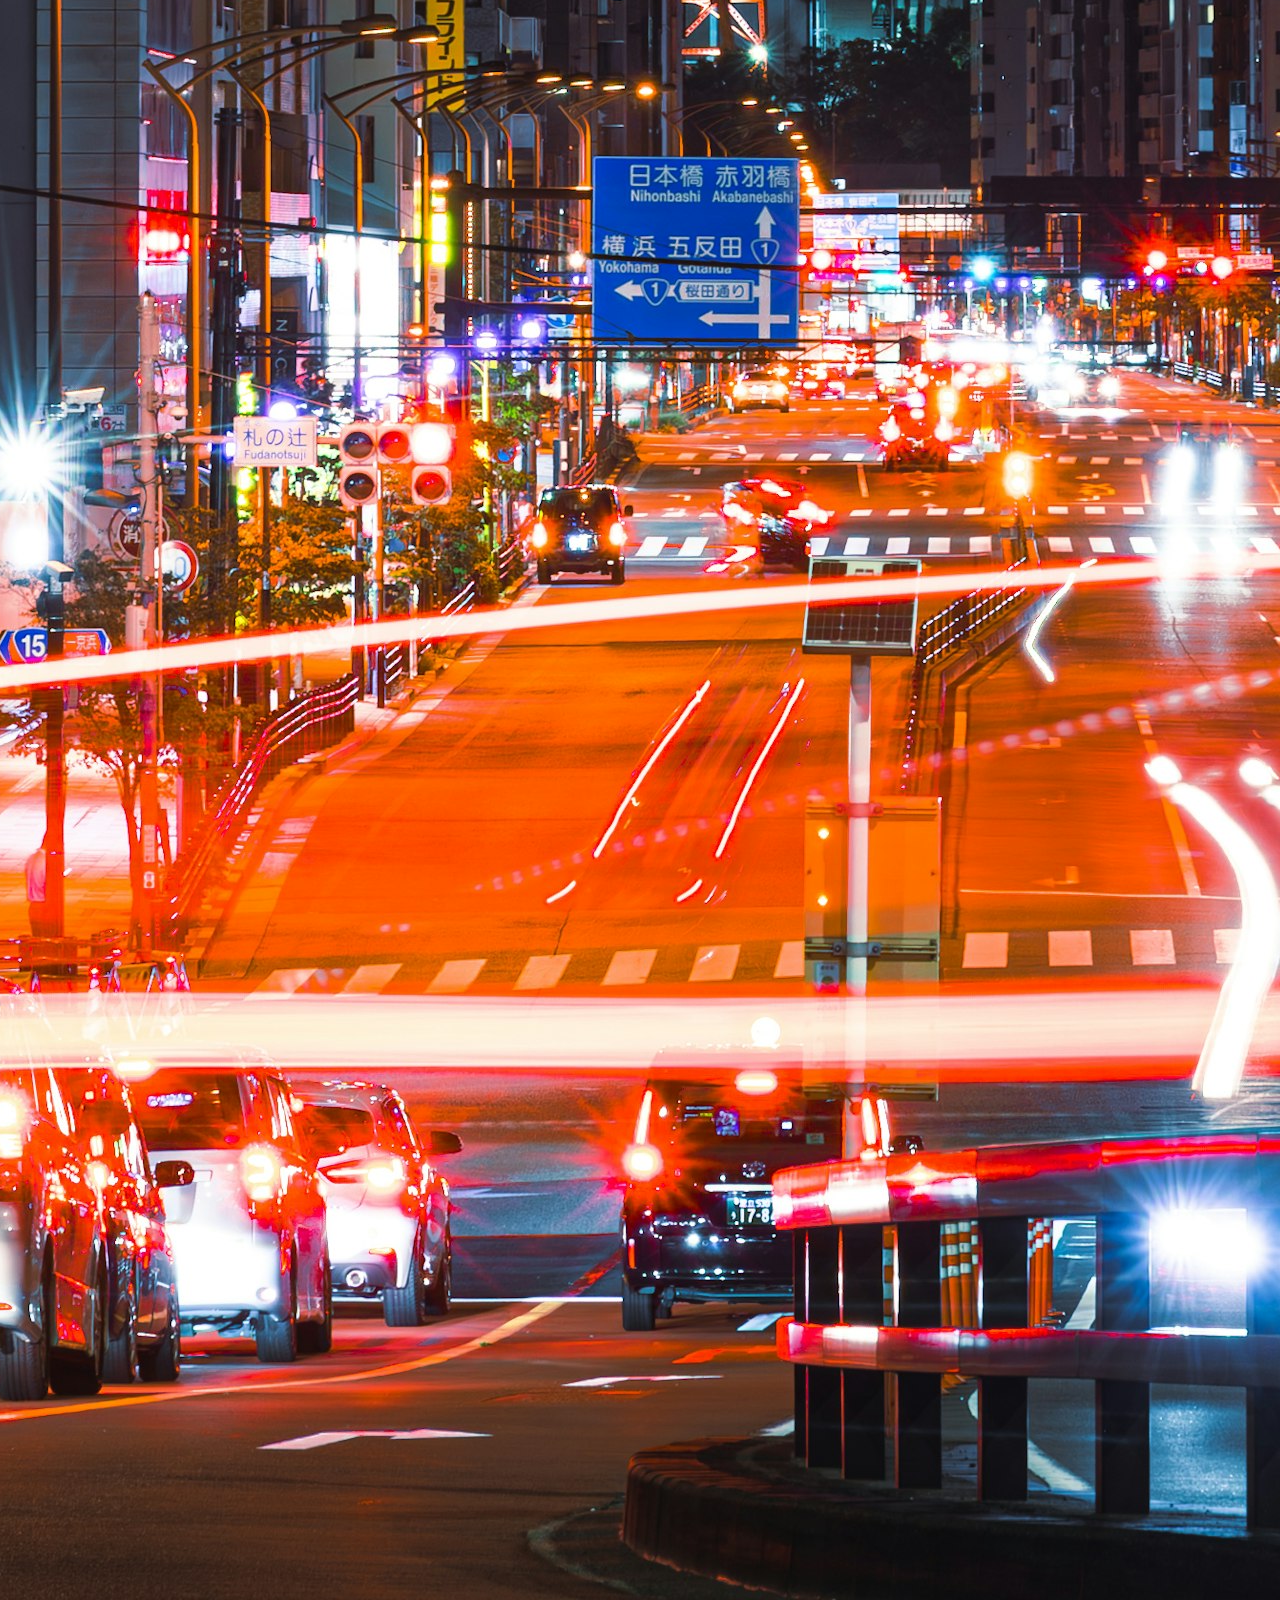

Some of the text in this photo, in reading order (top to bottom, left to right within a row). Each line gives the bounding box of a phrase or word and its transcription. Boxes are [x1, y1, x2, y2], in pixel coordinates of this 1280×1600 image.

[629, 164, 792, 188] 日本橋 赤羽橋
[630, 189, 794, 204] Nihonbashi Akabanebashi
[602, 235, 742, 259] 横浜 五反田
[760, 242, 769, 258] 1
[598, 260, 660, 275] Yokohama
[651, 282, 659, 298] 1
[685, 283, 746, 299] 桜田通り
[243, 428, 308, 447] 札の辻
[244, 450, 309, 461] Fudanotsuji
[21, 634, 48, 658] 15
[66, 634, 98, 651] 一京浜
